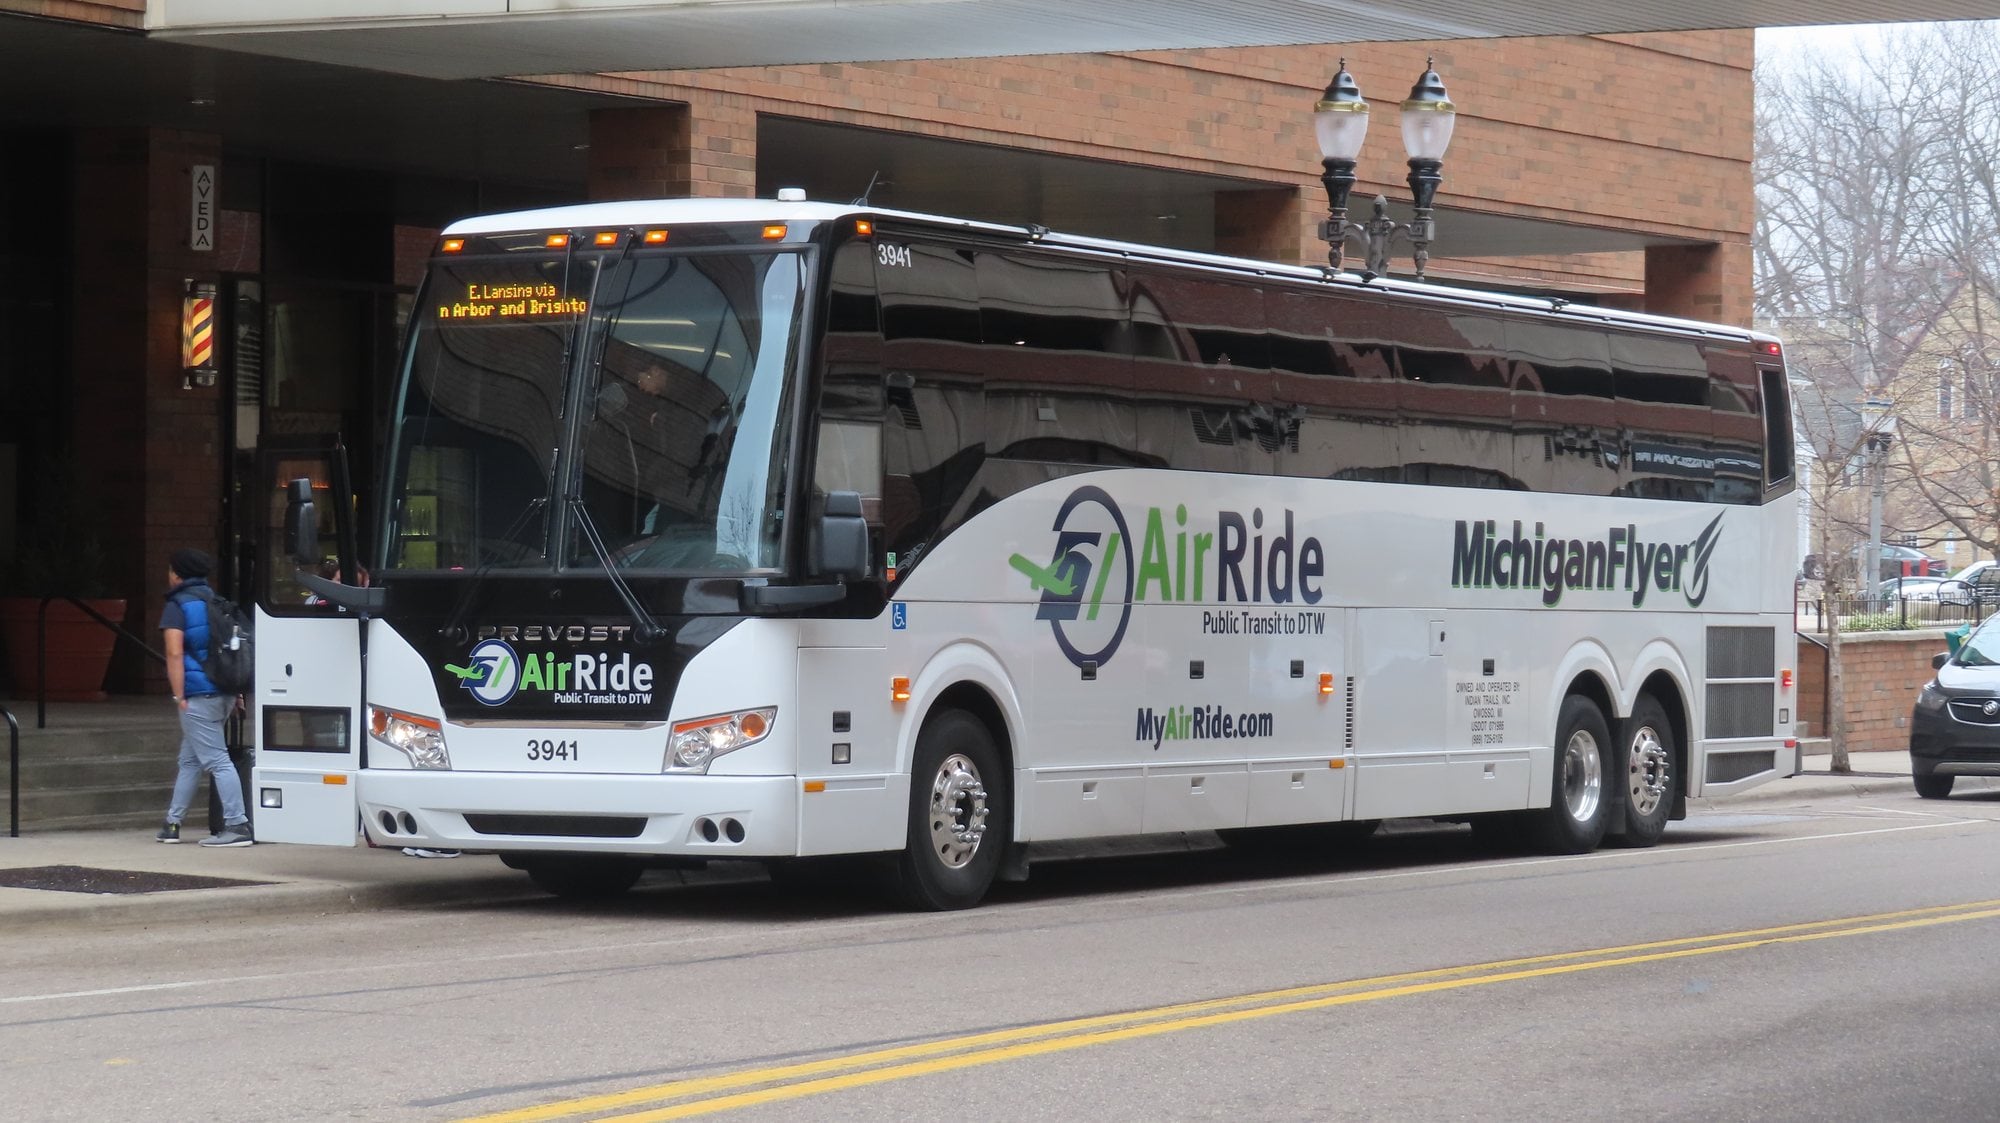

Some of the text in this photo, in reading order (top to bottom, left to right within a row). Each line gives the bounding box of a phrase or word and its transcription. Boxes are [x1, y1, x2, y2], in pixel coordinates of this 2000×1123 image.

[196, 170, 211, 247] AVEDA
[878, 243, 912, 268] 3941
[469, 282, 556, 300] E. Lansing via
[453, 303, 496, 317] Arbor
[500, 300, 526, 315] and
[529, 298, 587, 314] Brighto
[1134, 503, 1325, 605] AirRide
[1451, 519, 1690, 608] MichiganFlyer
[478, 625, 631, 642] PREVOST
[1203, 611, 1325, 635] Public Transit to DTW
[519, 651, 654, 691] AirRide
[1456, 682, 1473, 692] OWNED
[1476, 682, 1486, 692] AND
[1488, 681, 1511, 692] OPERATED
[554, 692, 652, 704] Public Transit to DTW
[1465, 695, 1481, 705] INDIAN
[1135, 704, 1273, 750] MyAirRide.com
[1471, 720, 1487, 731] USDOT
[527, 739, 578, 761] 3941
